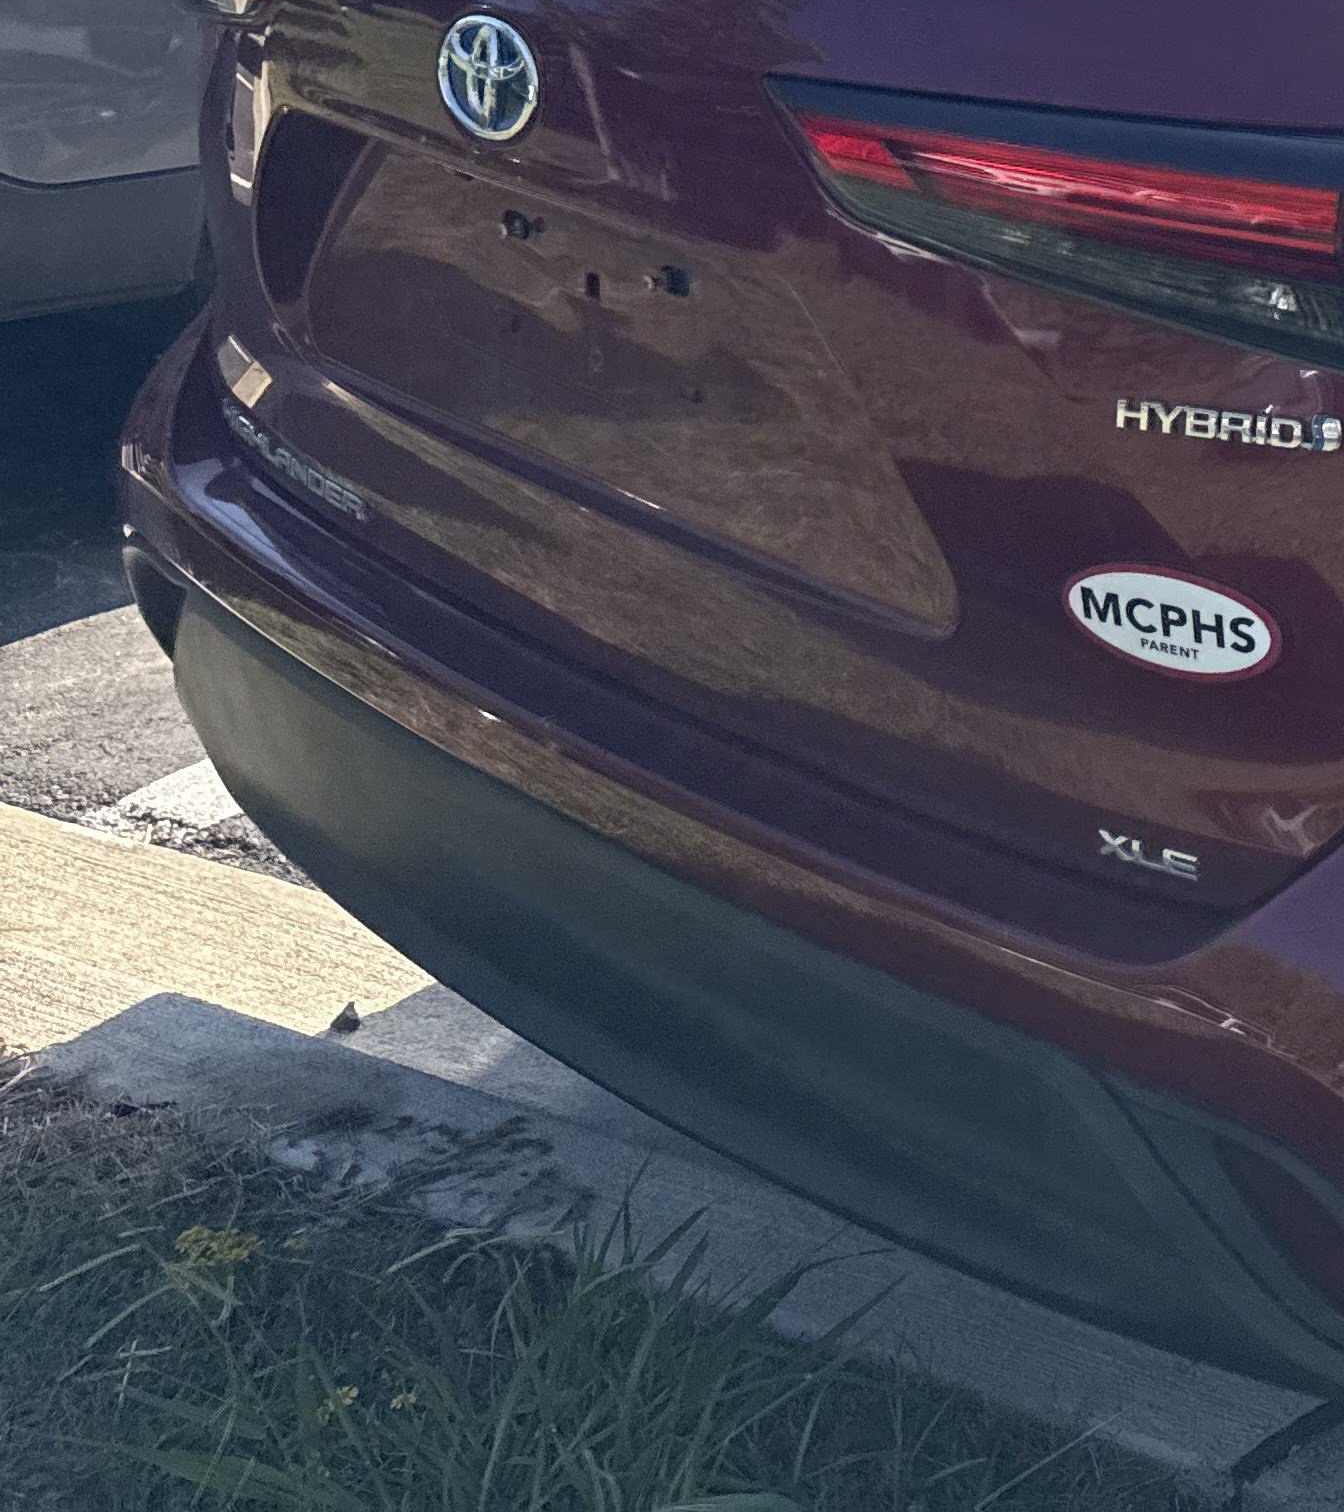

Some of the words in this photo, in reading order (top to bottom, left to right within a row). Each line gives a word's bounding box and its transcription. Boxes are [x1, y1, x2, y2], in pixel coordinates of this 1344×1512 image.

[1115, 399, 1303, 449] HYBRID
[1080, 586, 1257, 654] MCPHS
[1140, 637, 1199, 661] PARENT
[1098, 828, 1200, 882] XLE
